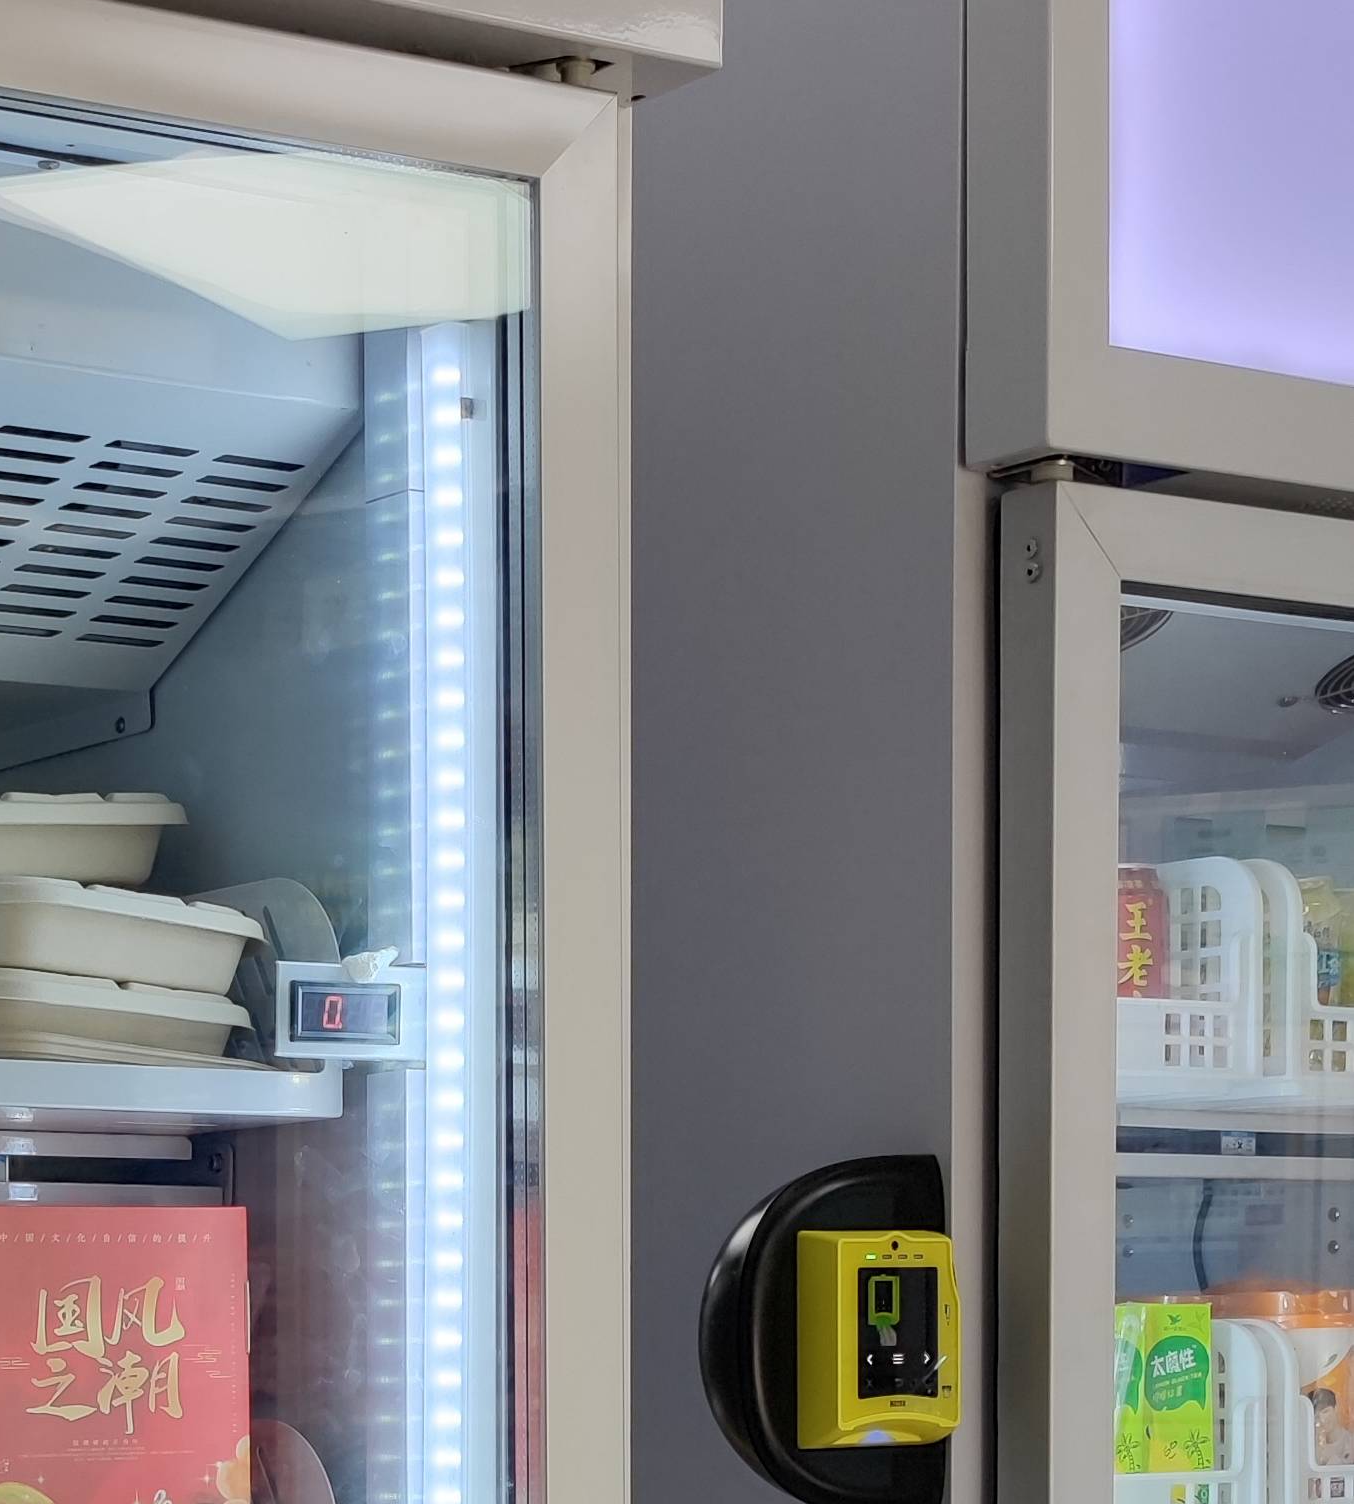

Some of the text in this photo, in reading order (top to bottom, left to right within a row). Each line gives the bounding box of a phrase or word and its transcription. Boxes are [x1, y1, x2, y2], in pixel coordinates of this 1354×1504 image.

[1118, 900, 1153, 997] 王老
[30, 1275, 186, 1370] 国风
[26, 1350, 183, 1434] 之潮
